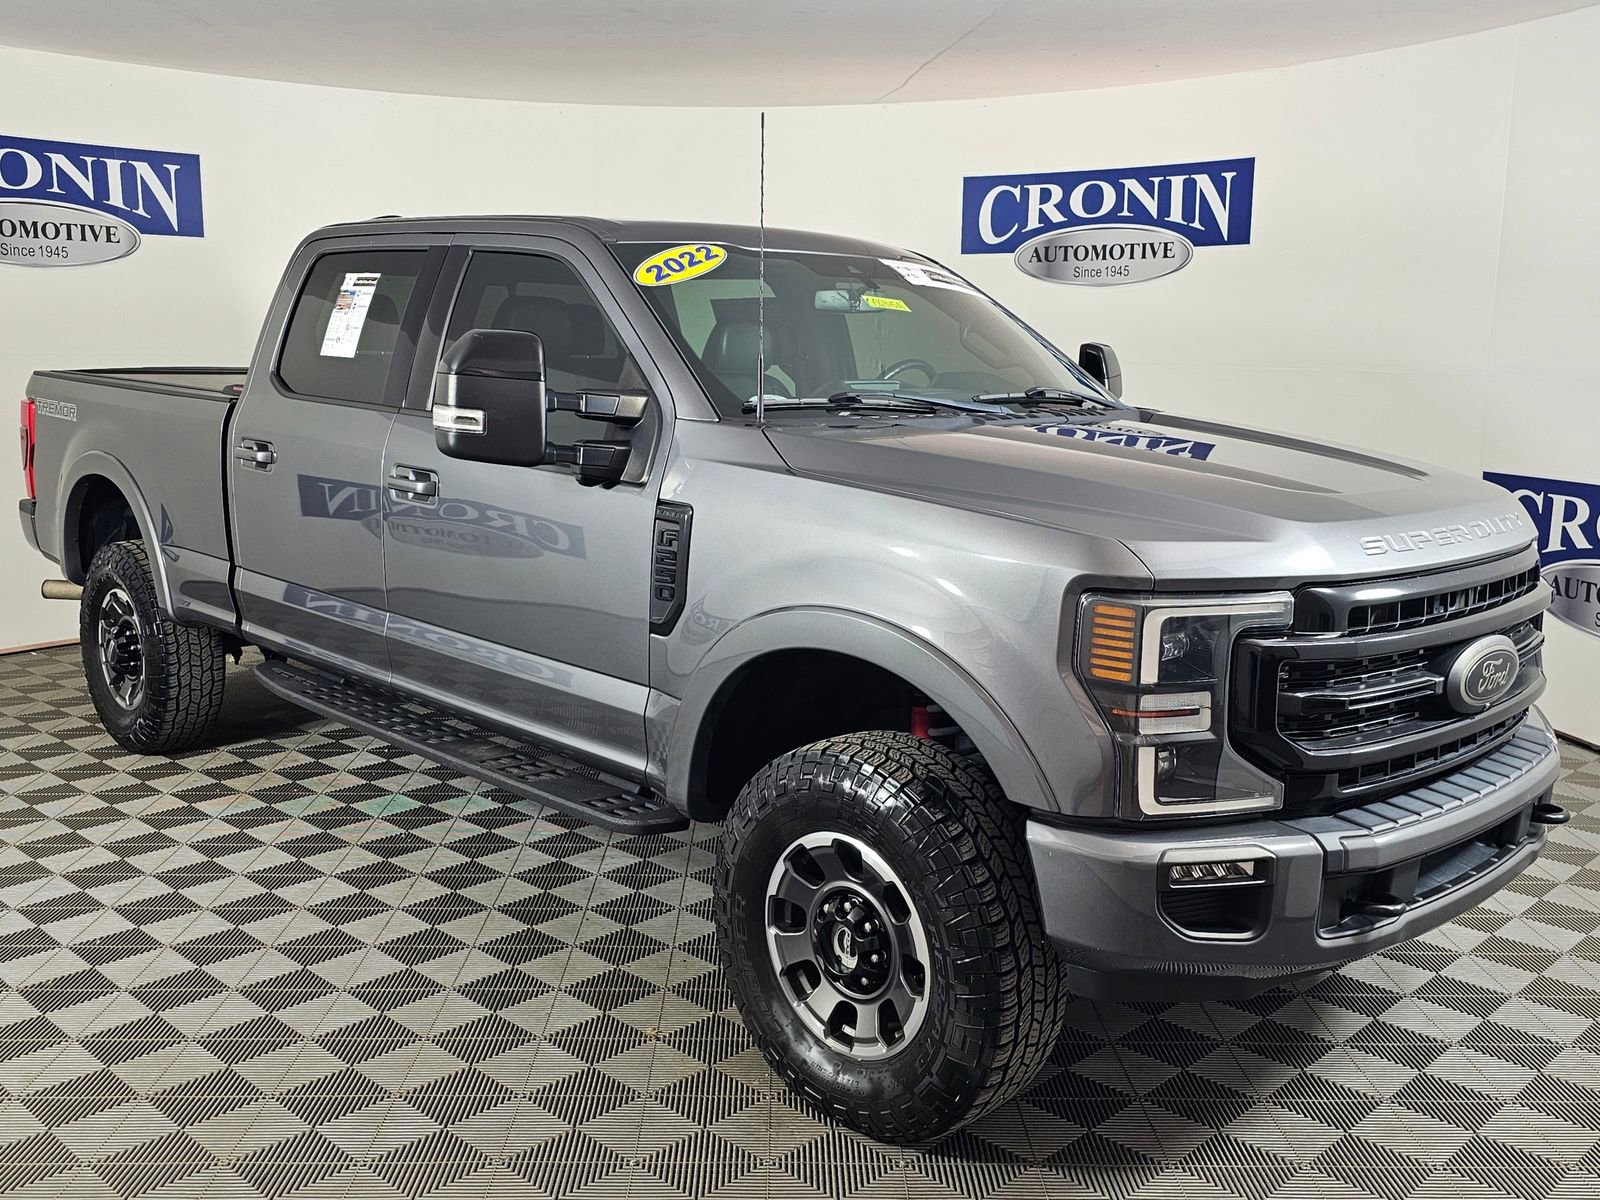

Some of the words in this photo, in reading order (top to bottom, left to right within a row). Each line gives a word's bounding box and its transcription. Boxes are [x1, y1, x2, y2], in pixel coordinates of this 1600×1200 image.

[978, 171, 1237, 245] CRONIN
[1, 243, 36, 258] Since
[40, 245, 69, 259] 1945
[646, 246, 720, 283] 2022
[1028, 241, 1176, 264] AUTOMOTIVE
[1073, 265, 1102, 279] Since
[1105, 265, 1130, 278] 1945
[36, 397, 77, 421] TREMOR
[1359, 525, 1472, 556] SUPER
[1470, 511, 1522, 539] DUTY
[1550, 574, 1600, 605] AUT
[1477, 657, 1510, 694] Ford
